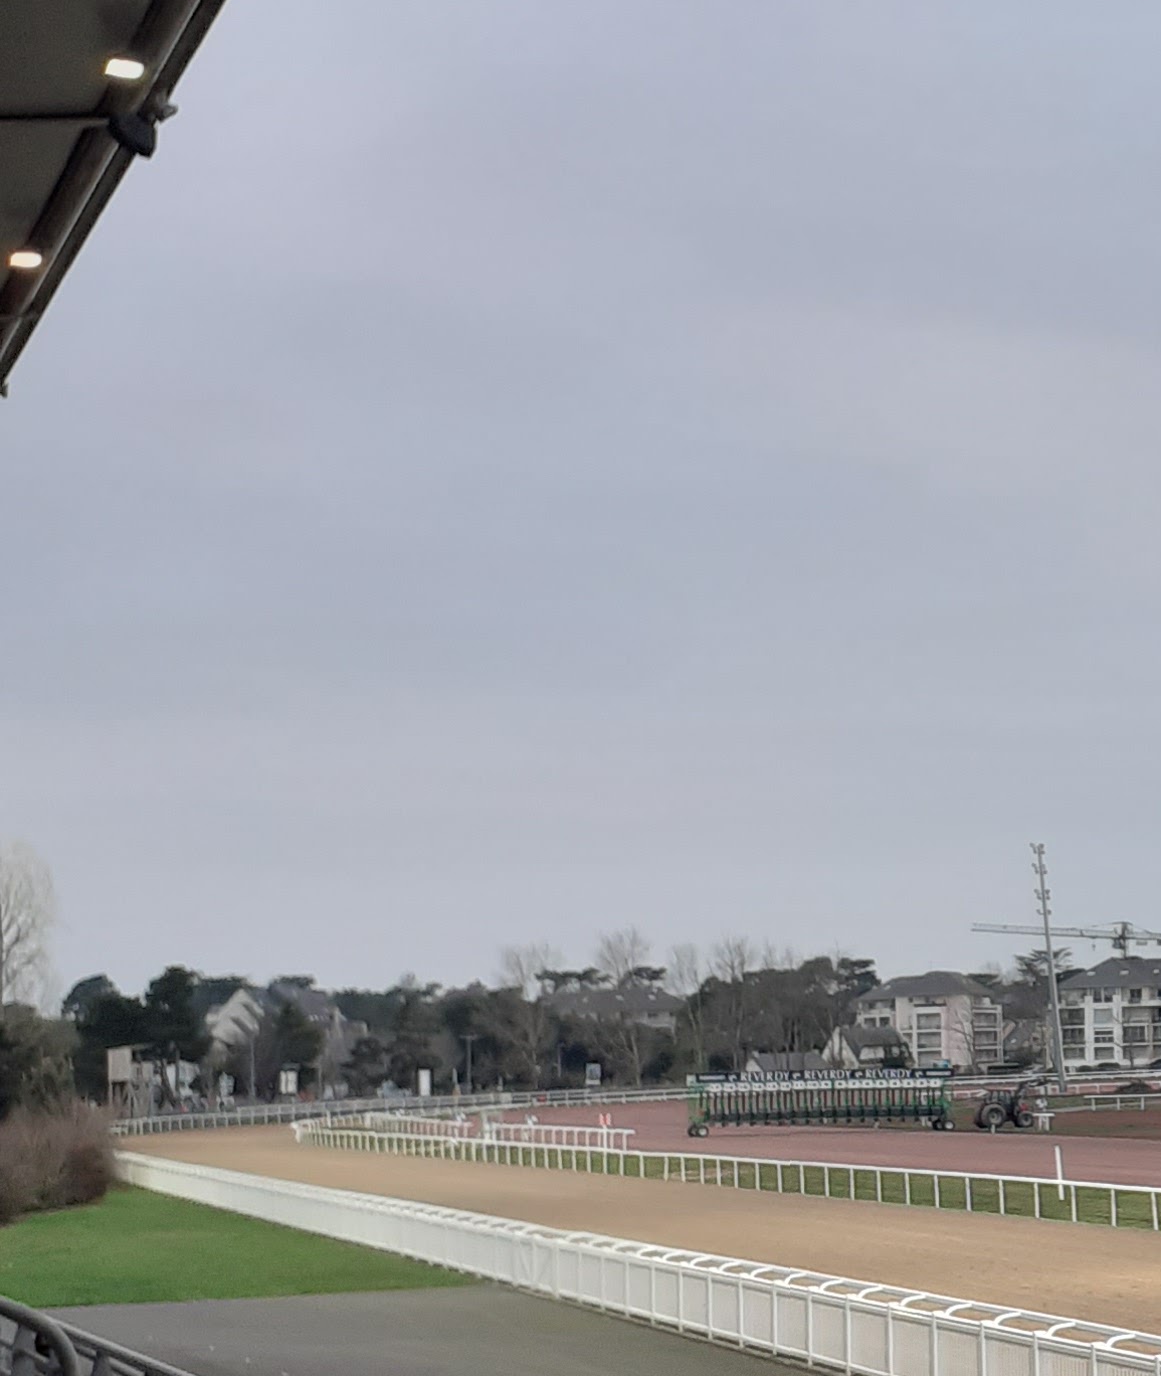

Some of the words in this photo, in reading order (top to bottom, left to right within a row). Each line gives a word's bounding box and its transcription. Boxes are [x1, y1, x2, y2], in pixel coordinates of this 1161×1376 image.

[740, 1070, 790, 1082] REVERDY
[804, 1069, 852, 1081] REVERDY
[865, 1068, 912, 1080] REVERDY
